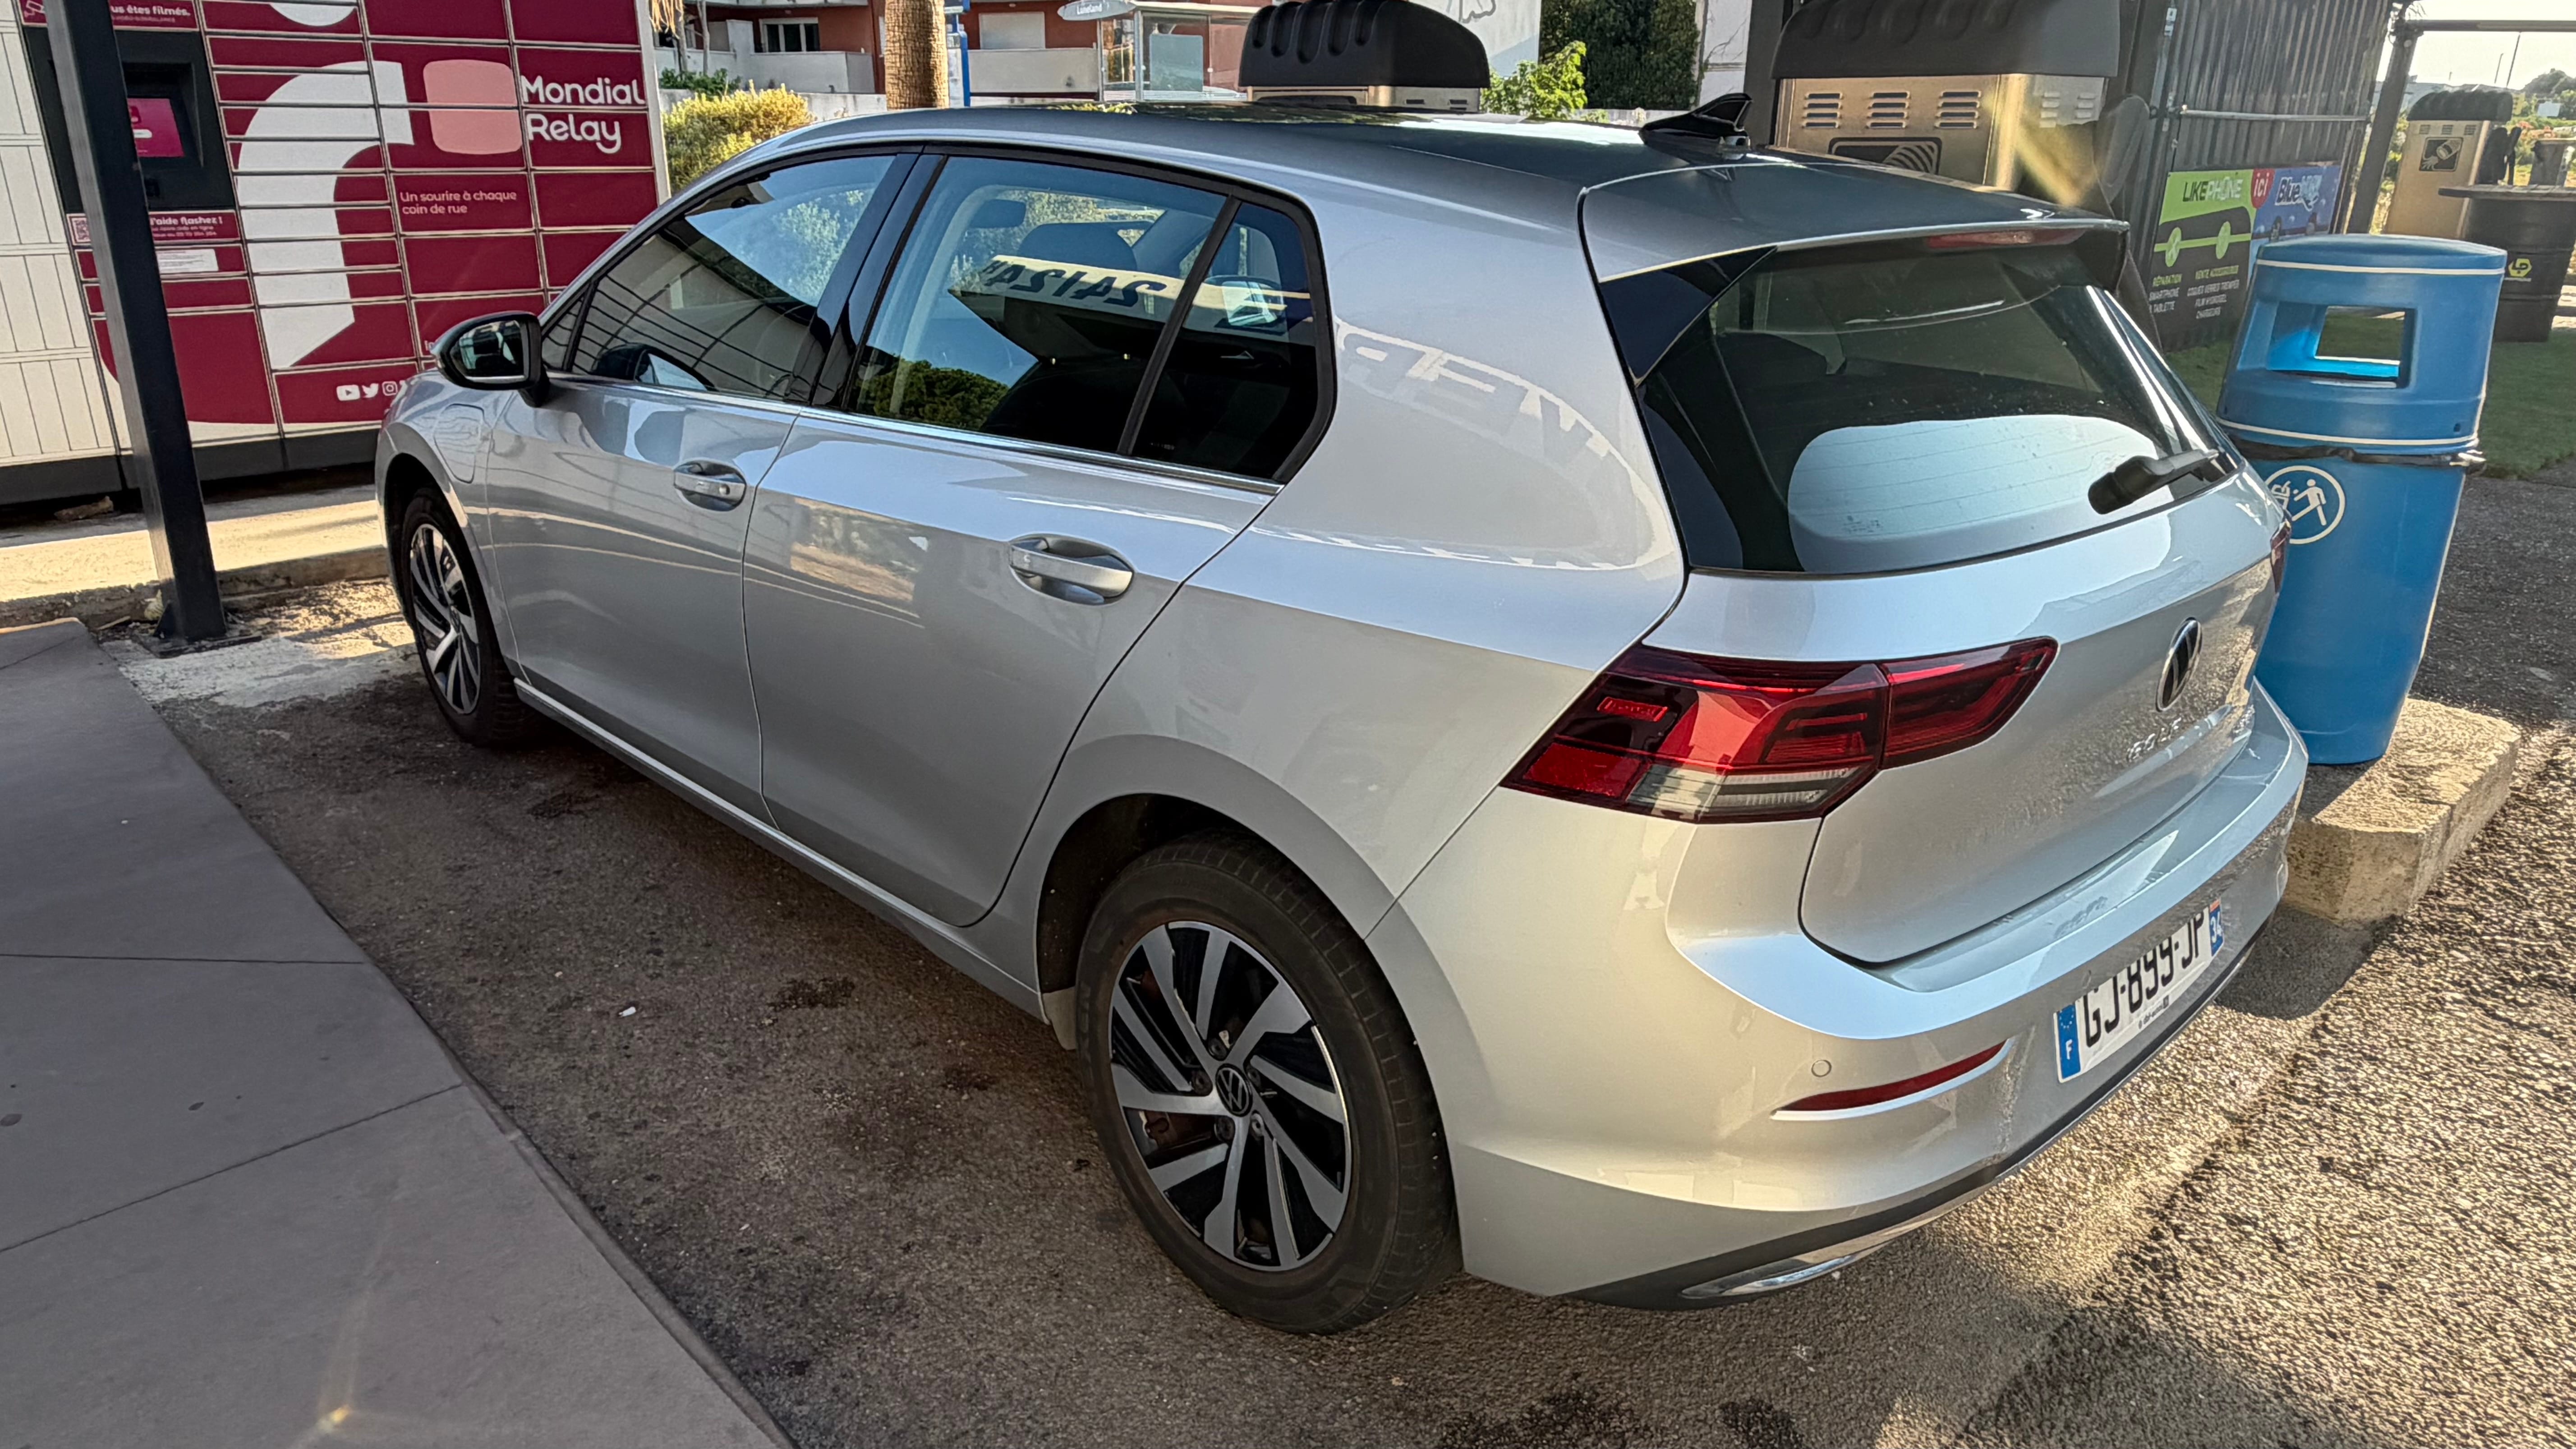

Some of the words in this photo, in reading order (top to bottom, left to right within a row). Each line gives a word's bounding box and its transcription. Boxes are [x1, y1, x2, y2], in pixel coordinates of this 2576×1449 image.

[520, 75, 645, 105] Mondial
[525, 114, 621, 154] Relay
[400, 192, 418, 202] Un
[420, 190, 460, 202] sourire
[463, 190, 472, 201] à
[473, 190, 517, 202] chaque
[2253, 172, 2270, 197] ici
[402, 204, 428, 214] coin
[429, 203, 446, 214] de
[447, 205, 468, 213] rue
[2065, 1039, 2073, 1060] F
